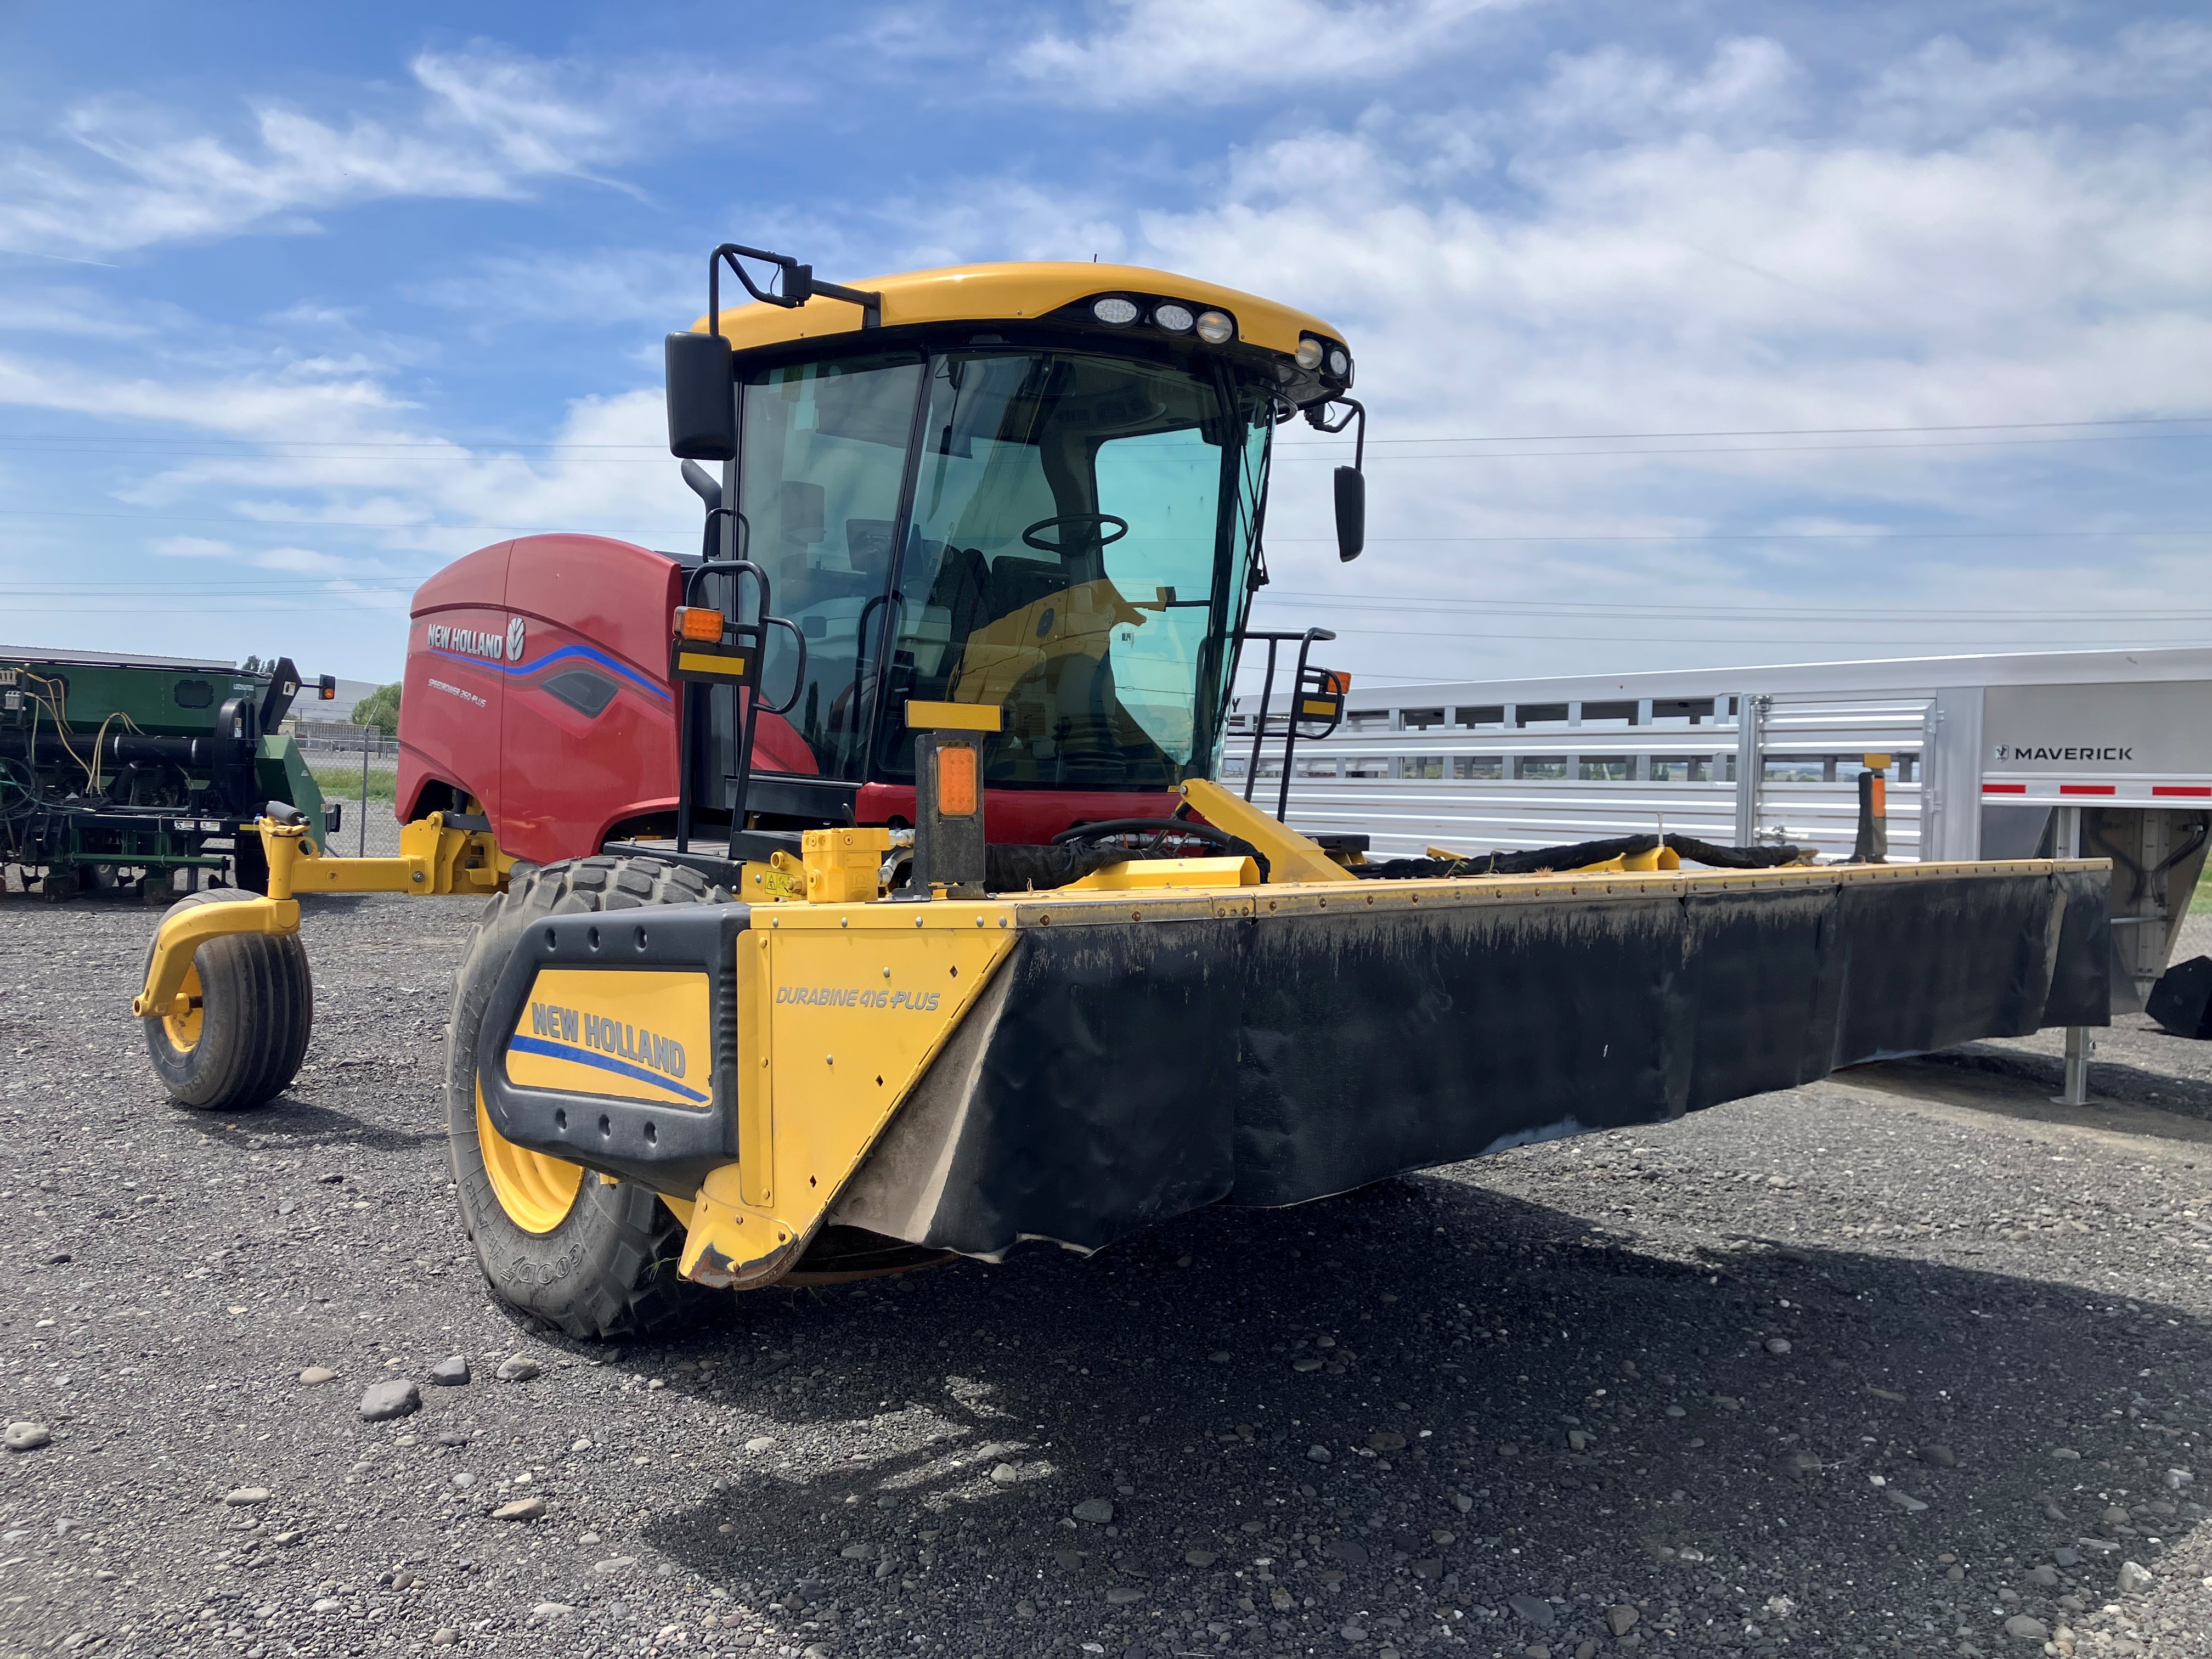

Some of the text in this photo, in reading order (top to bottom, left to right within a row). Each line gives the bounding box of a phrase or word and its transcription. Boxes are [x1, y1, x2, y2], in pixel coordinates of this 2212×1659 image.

[428, 624, 503, 659] NEW HOLLAND
[428, 678, 460, 696] SPEEDROWER
[472, 695, 487, 708] PLUS
[2015, 747, 2134, 761] MAVERICK
[776, 986, 941, 1011] DURABINE 416 PLUS
[532, 1002, 579, 1042] NEW
[584, 1013, 686, 1079] HOLLAND
